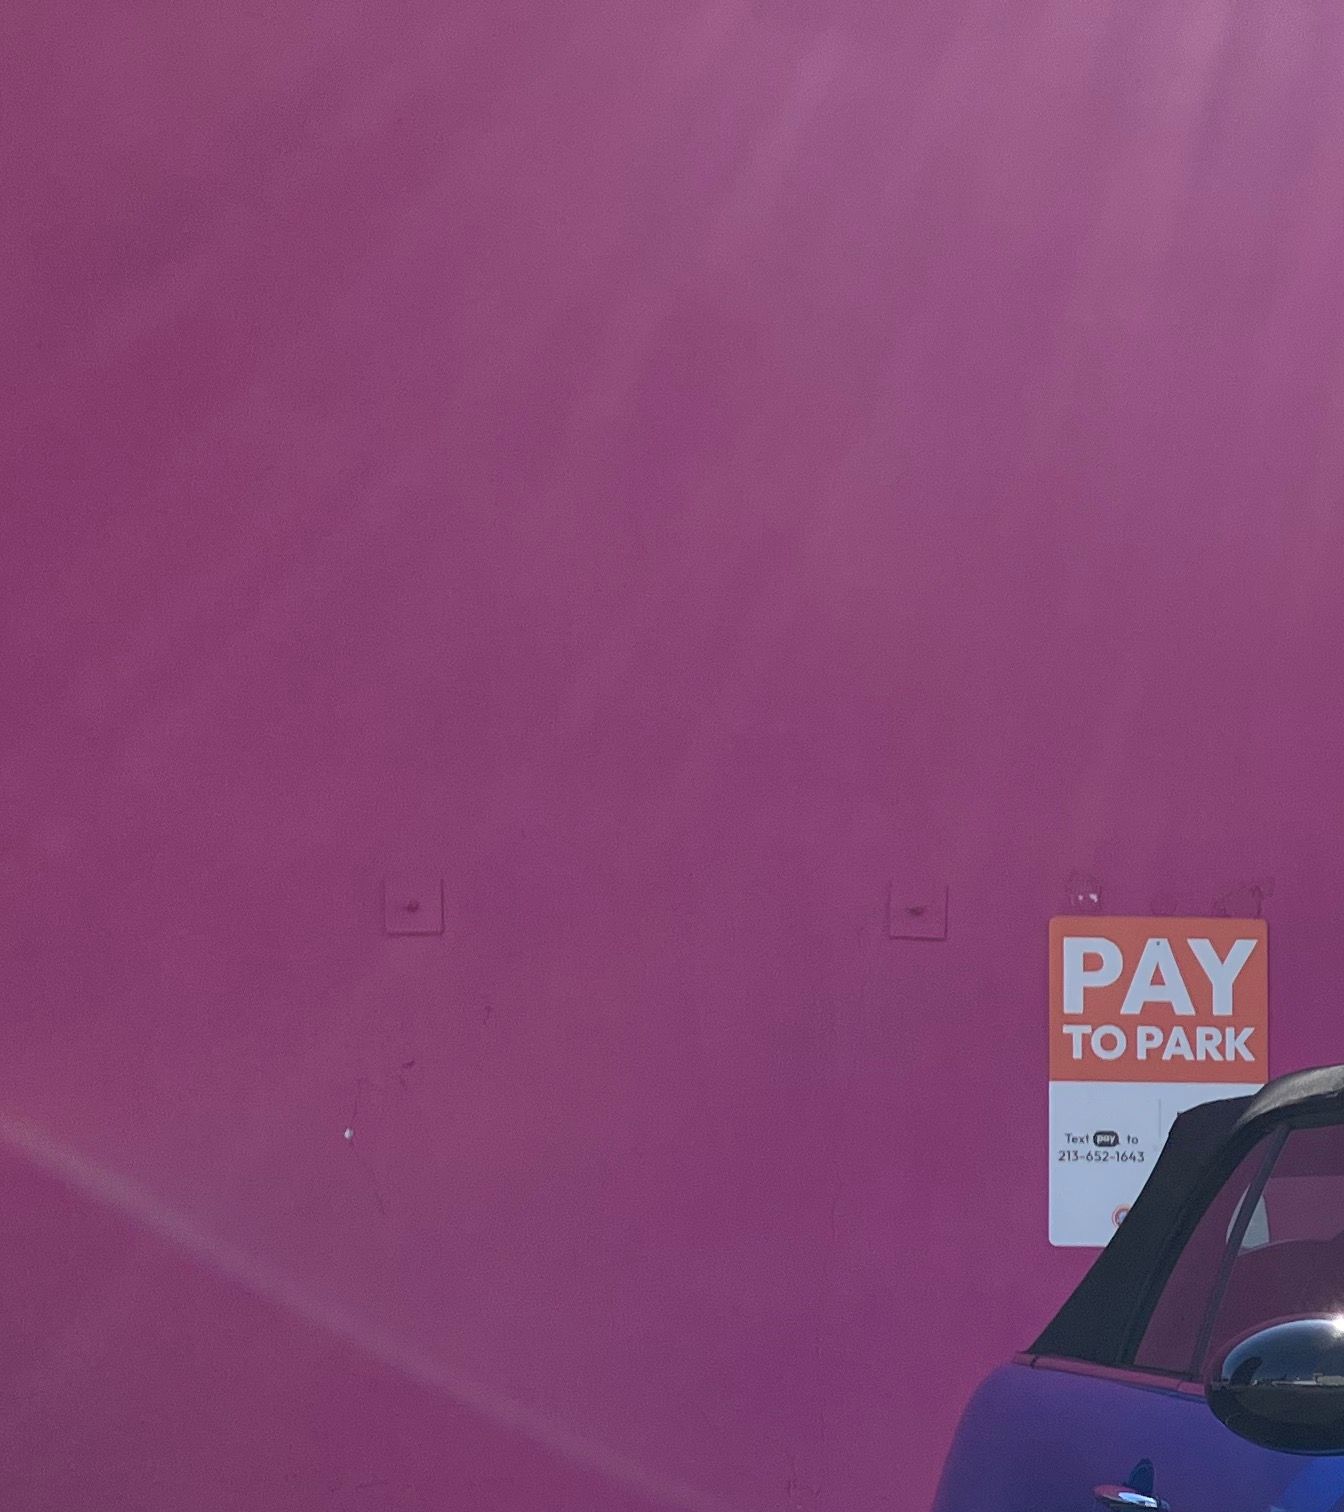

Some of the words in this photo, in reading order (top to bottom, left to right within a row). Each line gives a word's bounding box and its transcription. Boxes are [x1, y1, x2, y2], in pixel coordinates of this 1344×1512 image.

[1063, 936, 1259, 1016] PAY
[1062, 1024, 1127, 1060] TO
[1136, 1026, 1256, 1062] PARK
[1064, 1132, 1090, 1144] Text
[1127, 1134, 1139, 1144] to
[1058, 1150, 1145, 1162] 213-652-1643
